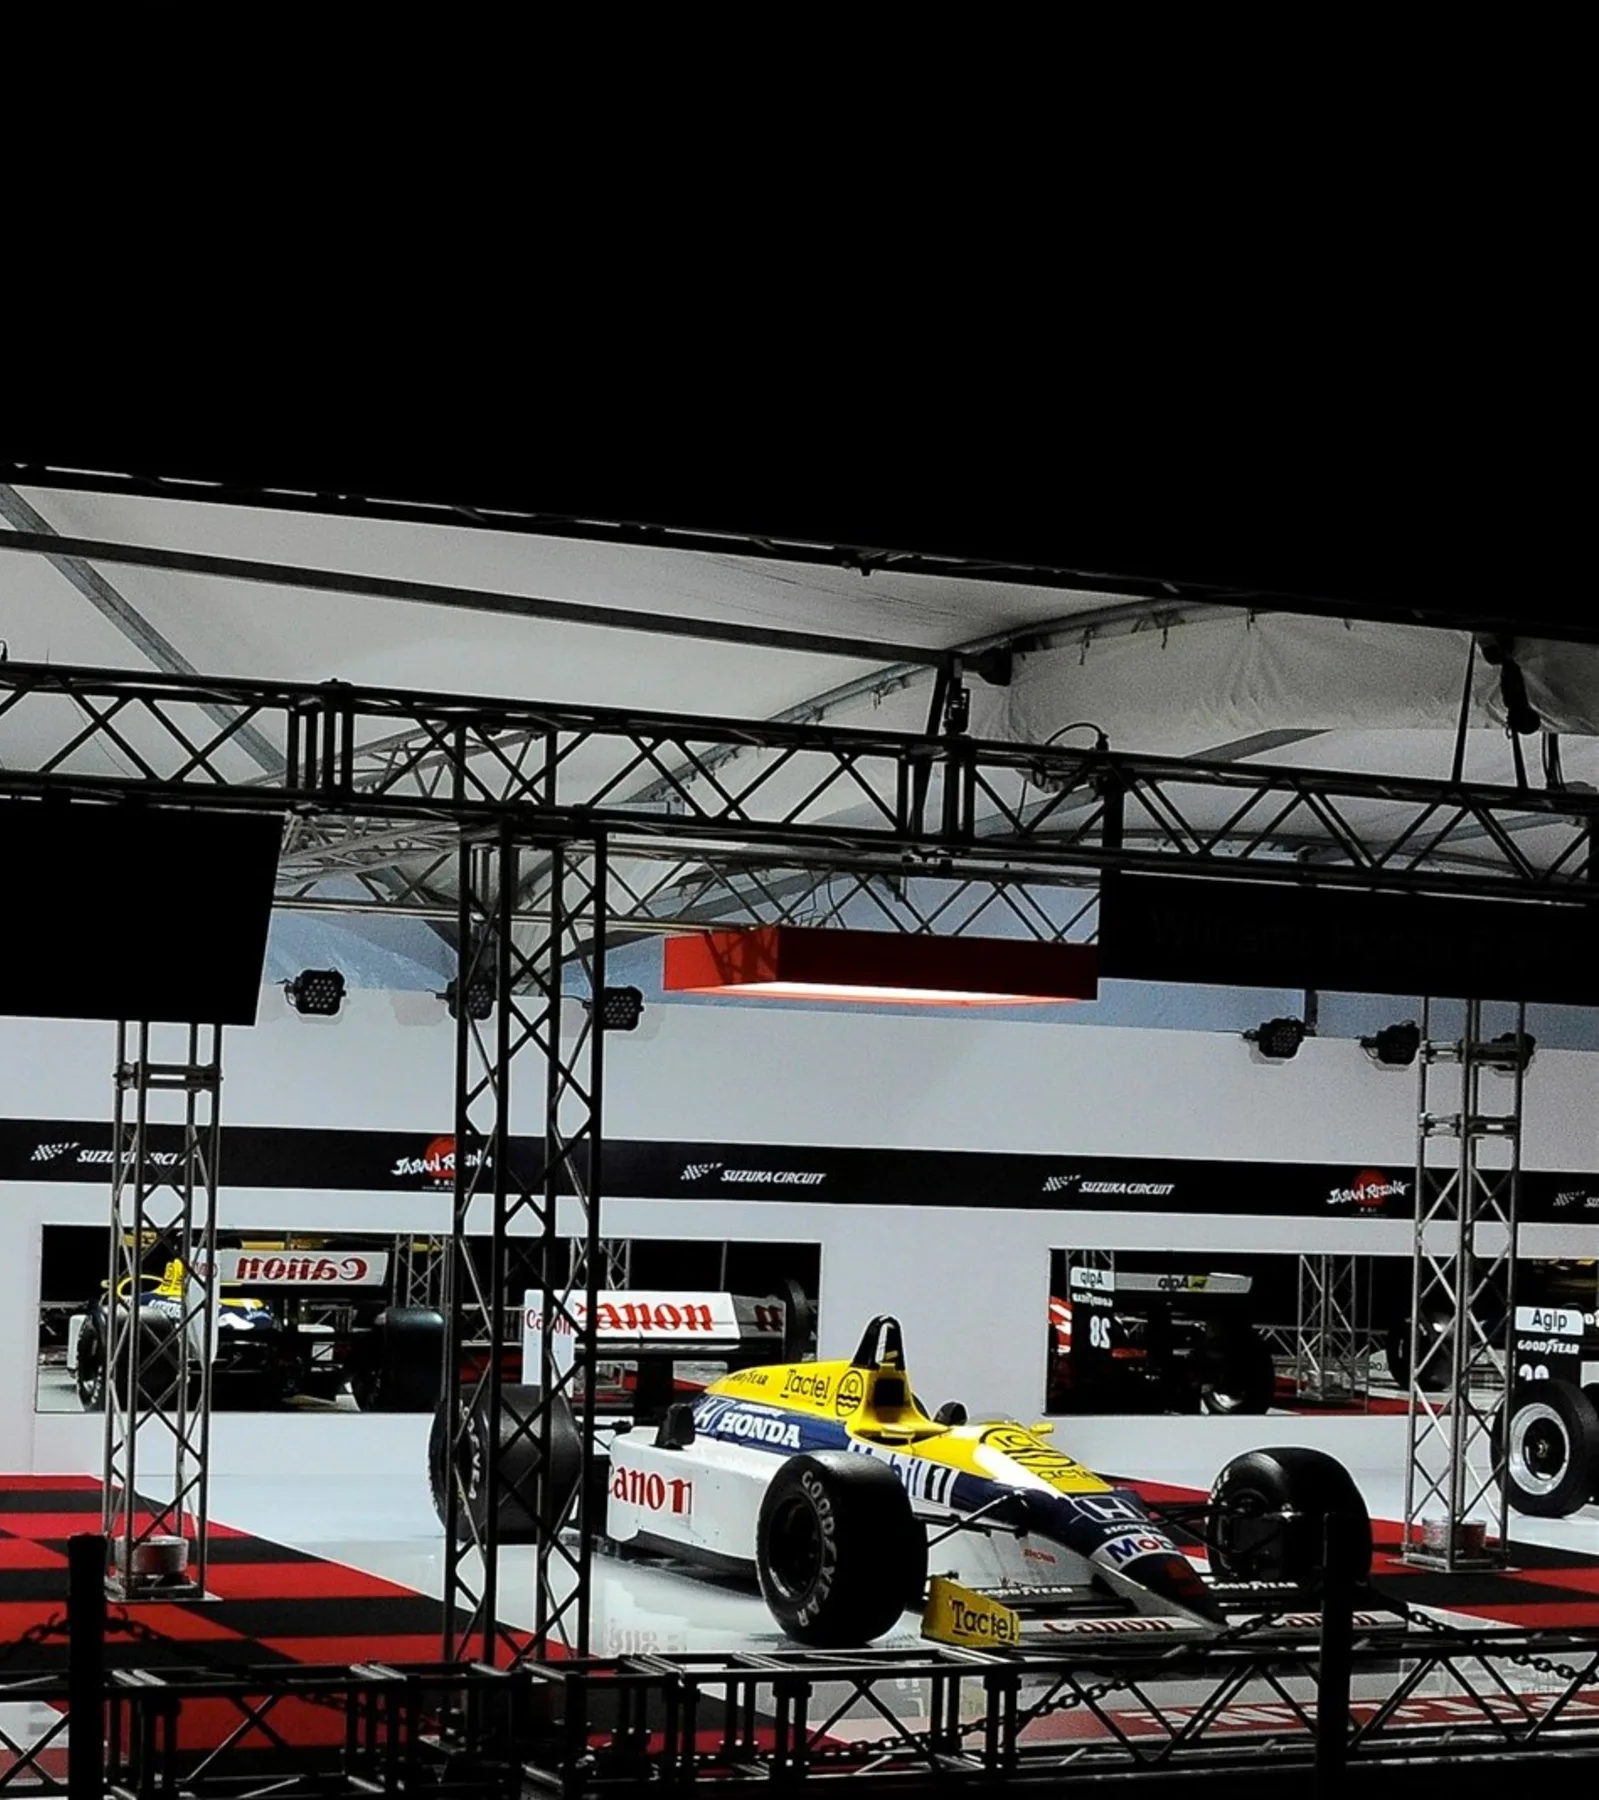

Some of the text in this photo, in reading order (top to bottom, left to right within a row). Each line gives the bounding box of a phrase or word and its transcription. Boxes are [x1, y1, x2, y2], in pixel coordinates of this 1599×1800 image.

[391, 1152, 440, 1175] JAPAN
[720, 1169, 827, 1184] SUZUKA CIRCUIT
[1078, 1181, 1175, 1195] SUZUKA CIRCUIT
[575, 1302, 714, 1331] anon
[1532, 1309, 1568, 1331] Agip
[1518, 1339, 1580, 1355] GOODYEAR
[784, 1368, 831, 1399] Tactel
[717, 1411, 800, 1449] HONDA
[608, 1466, 692, 1515] anon
[951, 1600, 1017, 1641] Tactel
